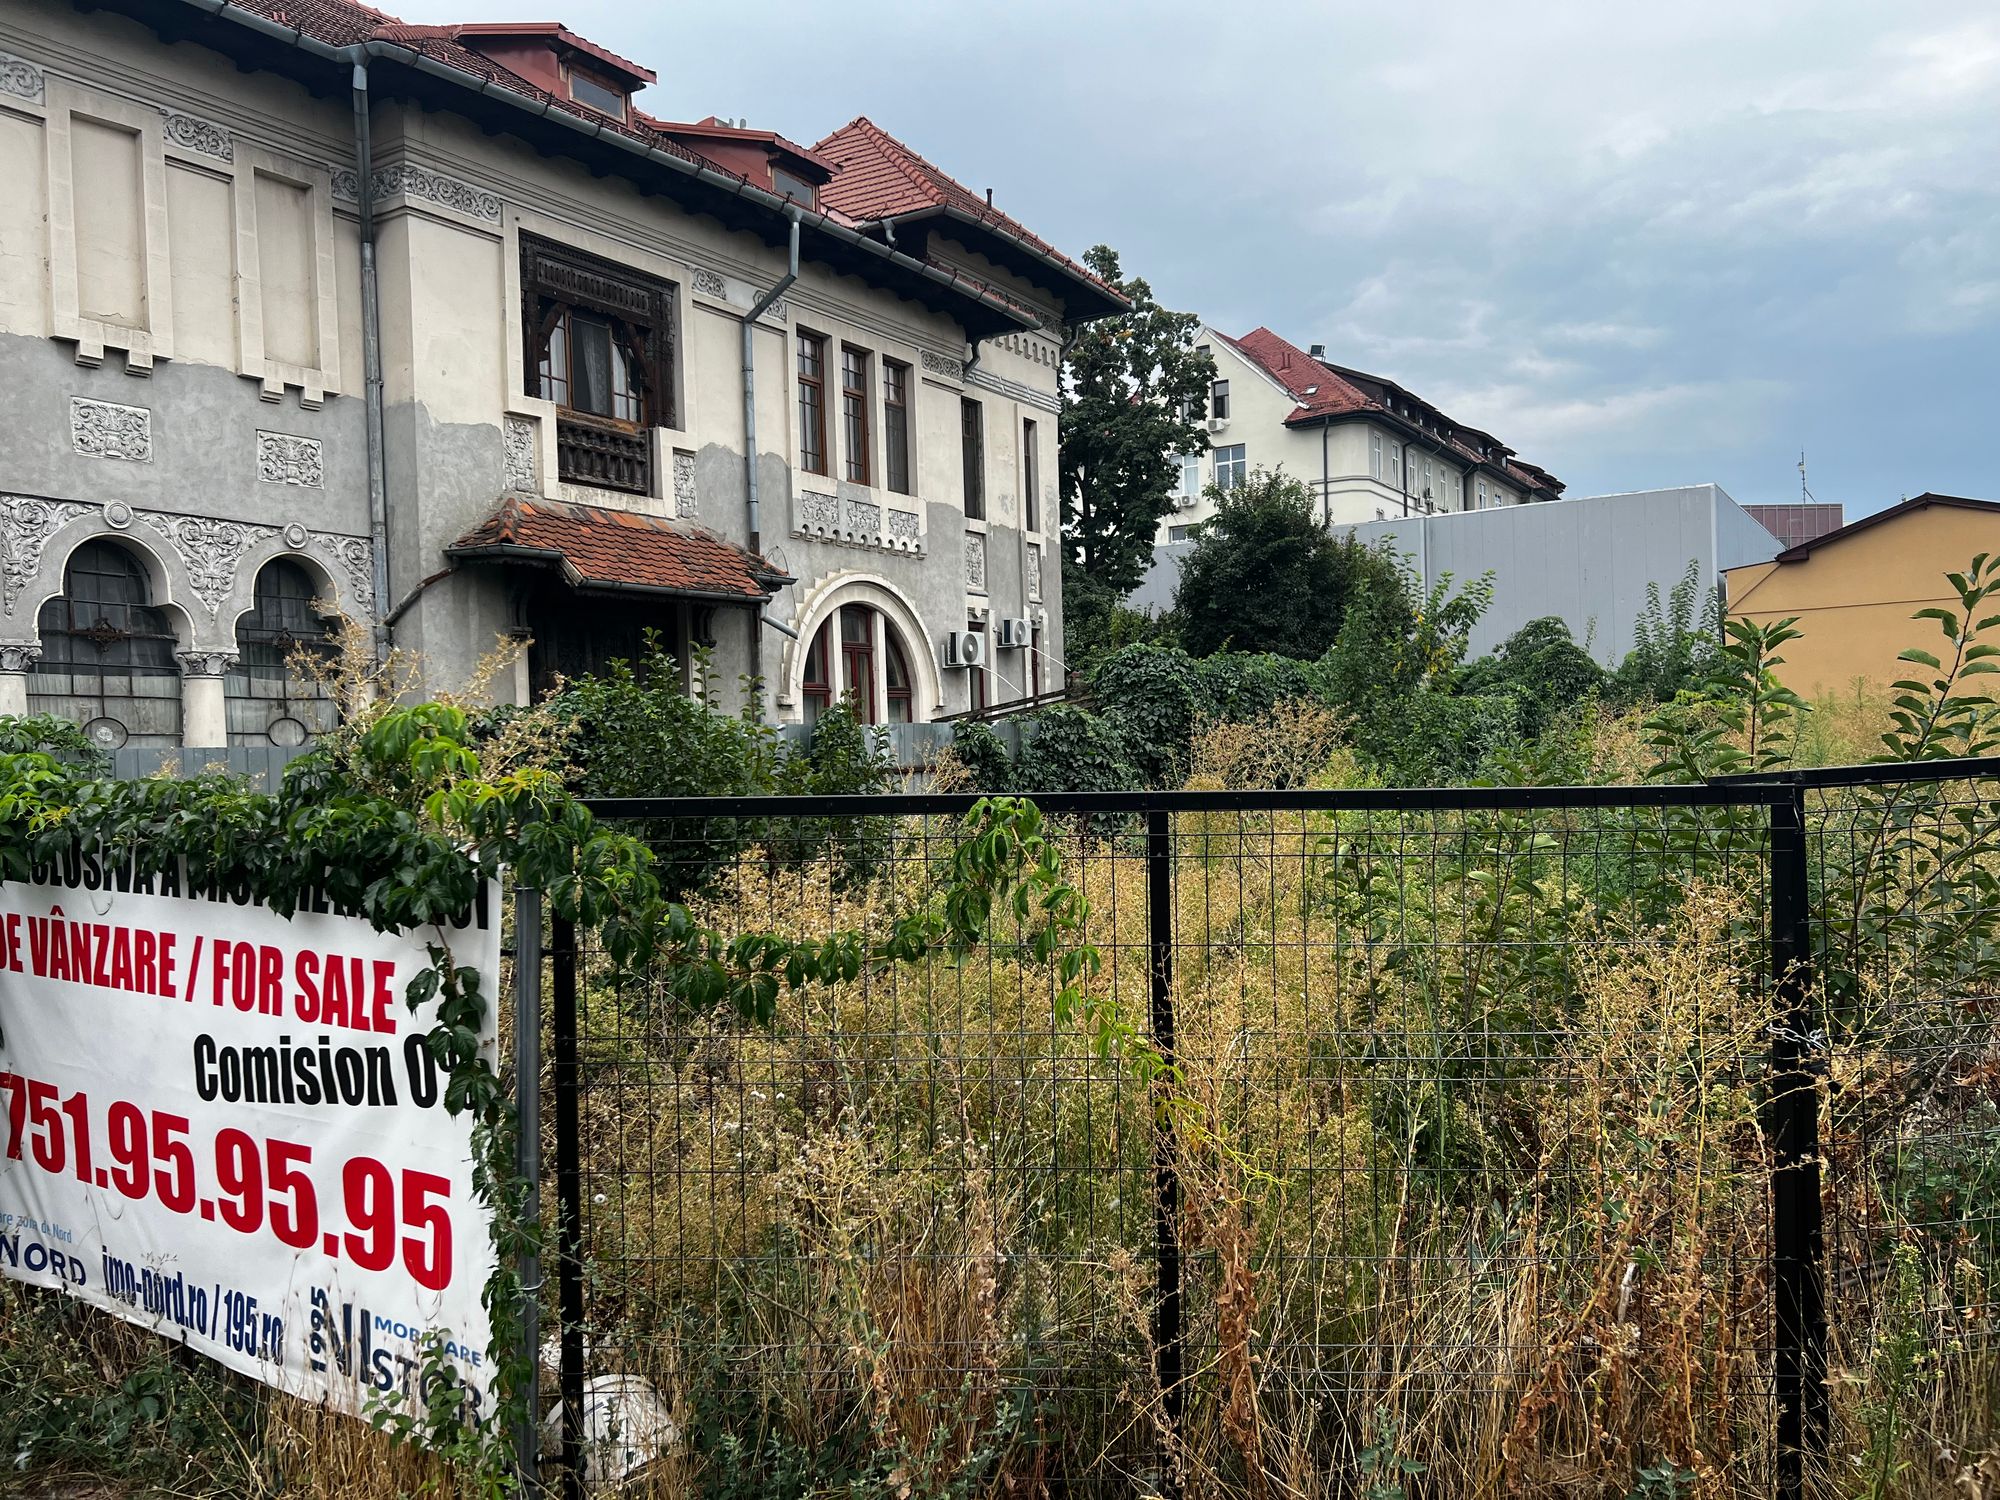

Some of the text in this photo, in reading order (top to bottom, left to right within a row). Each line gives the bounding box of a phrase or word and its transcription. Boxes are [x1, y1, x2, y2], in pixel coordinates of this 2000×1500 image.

[28, 905, 176, 998] VÂNZARE
[185, 936, 204, 1002] /
[213, 939, 284, 1017] FOR
[295, 950, 397, 1034] SALE
[194, 1033, 476, 1110] Comision 0
[0, 1072, 453, 1291] 751.95.95.95
[102, 1245, 285, 1366] imo-nord.ro / 195.ro
[374, 1316, 482, 1368] MOBLARE
